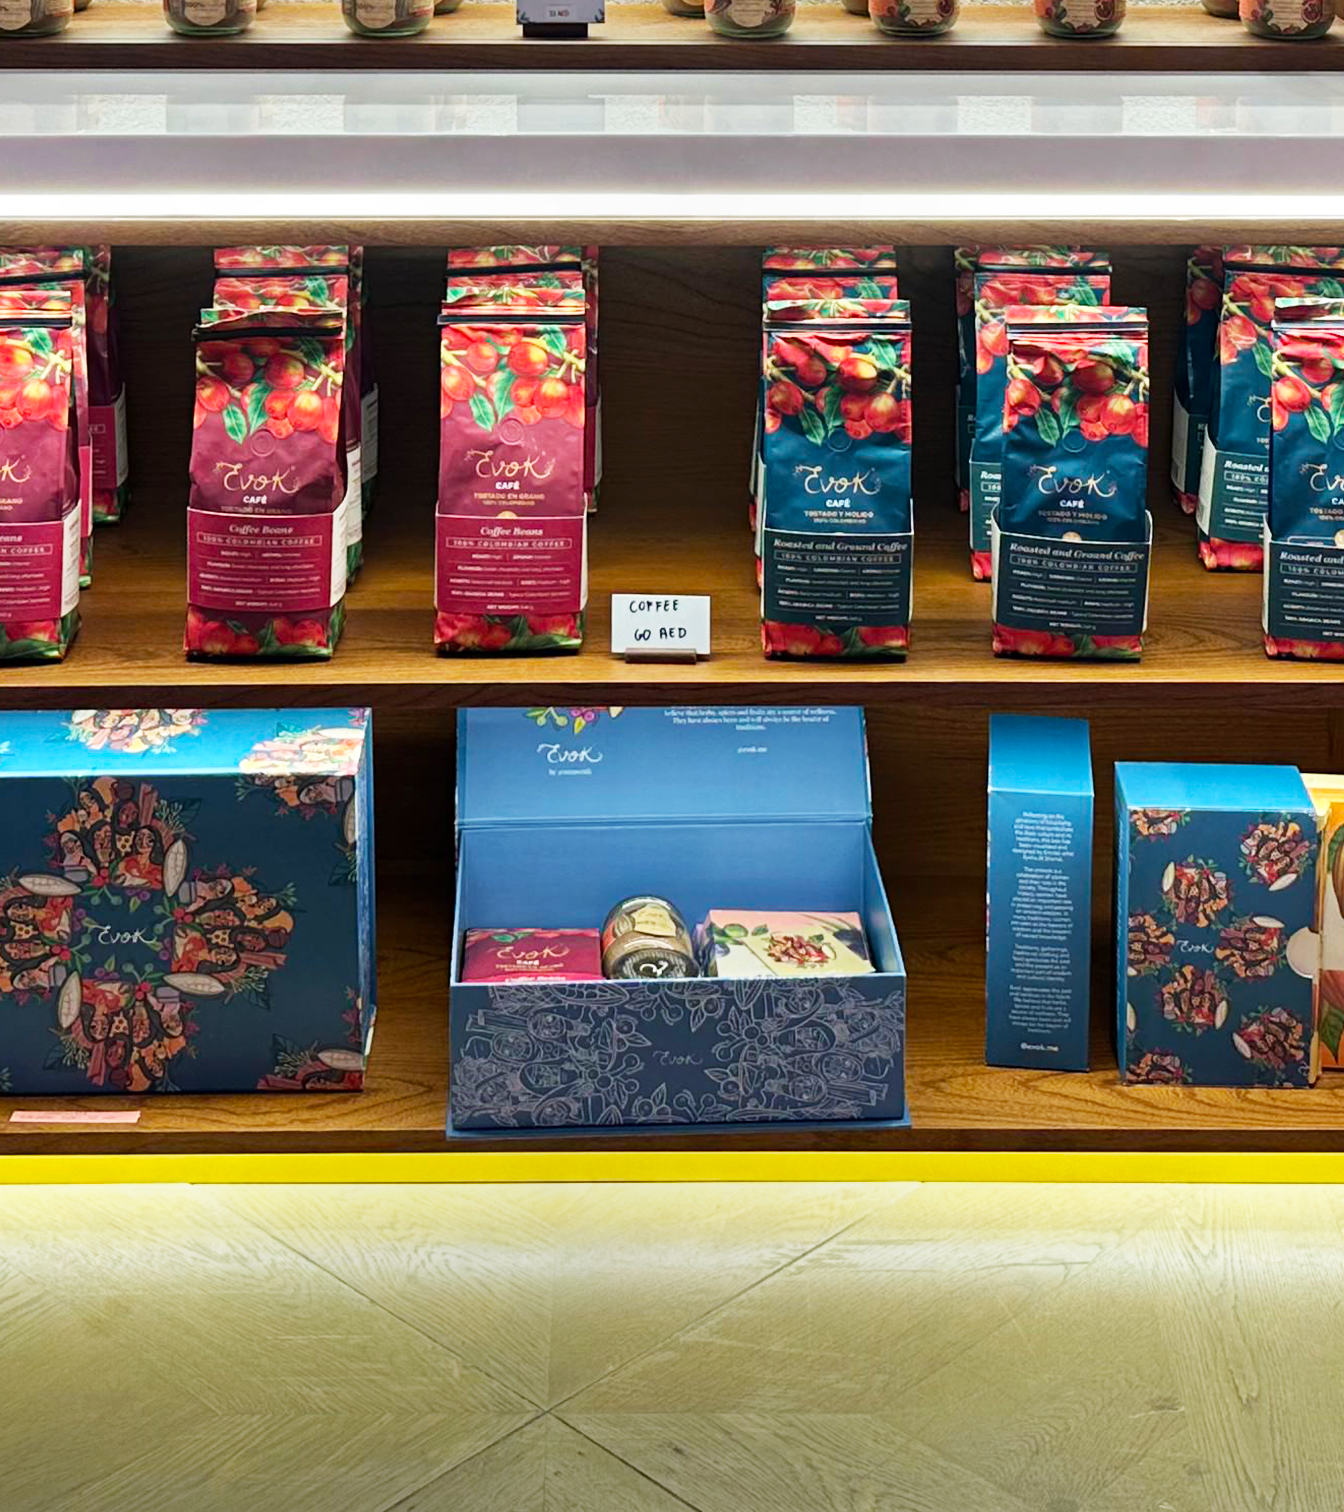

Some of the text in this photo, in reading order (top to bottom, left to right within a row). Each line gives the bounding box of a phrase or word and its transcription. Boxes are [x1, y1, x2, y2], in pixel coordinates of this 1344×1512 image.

[1224, 460, 1263, 473] Roasted
[495, 481, 520, 490] CAFÉ
[242, 495, 268, 504] CAFÉ
[825, 498, 851, 508] CAFÉ
[1059, 499, 1085, 509] CAFÉ
[804, 510, 838, 518] TOSTADO
[845, 511, 874, 519] MOLIDO
[229, 524, 294, 535] Coffee Beans
[480, 526, 544, 538] Coffee Beans
[281, 538, 315, 546] COFFEE
[773, 538, 908, 553] Roasted and Ground Coffee
[1009, 543, 1145, 562] Roasted and Ground Coffee
[1279, 551, 1322, 563] Roasted
[1323, 554, 1344, 564] and
[629, 599, 679, 613] COFFEE
[659, 627, 687, 640] AED
